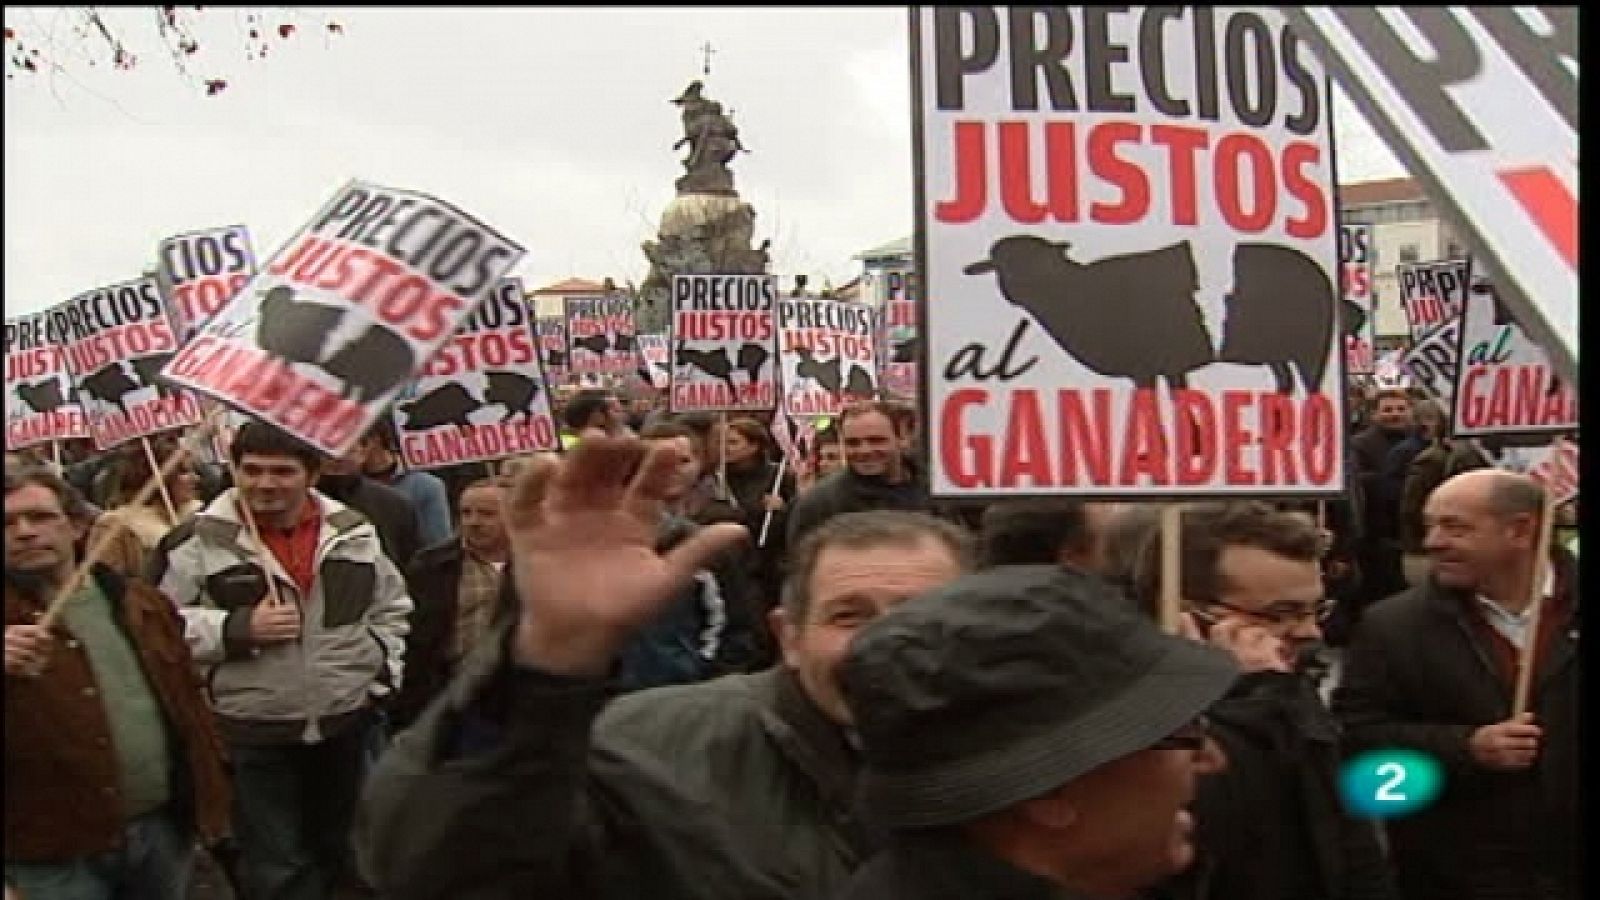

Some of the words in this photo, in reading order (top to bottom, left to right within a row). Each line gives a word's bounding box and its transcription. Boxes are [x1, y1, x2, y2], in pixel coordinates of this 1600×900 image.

[935, 6, 1321, 135] PRECIOS
[933, 120, 1329, 239] JUSTOS
[313, 190, 513, 296] PRECIOS
[56, 284, 162, 345] PRECIOS
[268, 234, 464, 341] JUSTOS
[676, 277, 771, 310] PRECIOS
[66, 319, 173, 376] JUSTOS
[674, 311, 771, 340] JUSTOS
[779, 301, 869, 336] PRECIOS
[782, 328, 871, 361] JUSTOS
[1466, 328, 1514, 365] al
[943, 319, 1041, 381] al
[403, 413, 554, 466] GANADERO
[938, 388, 1337, 488] GANADERO
